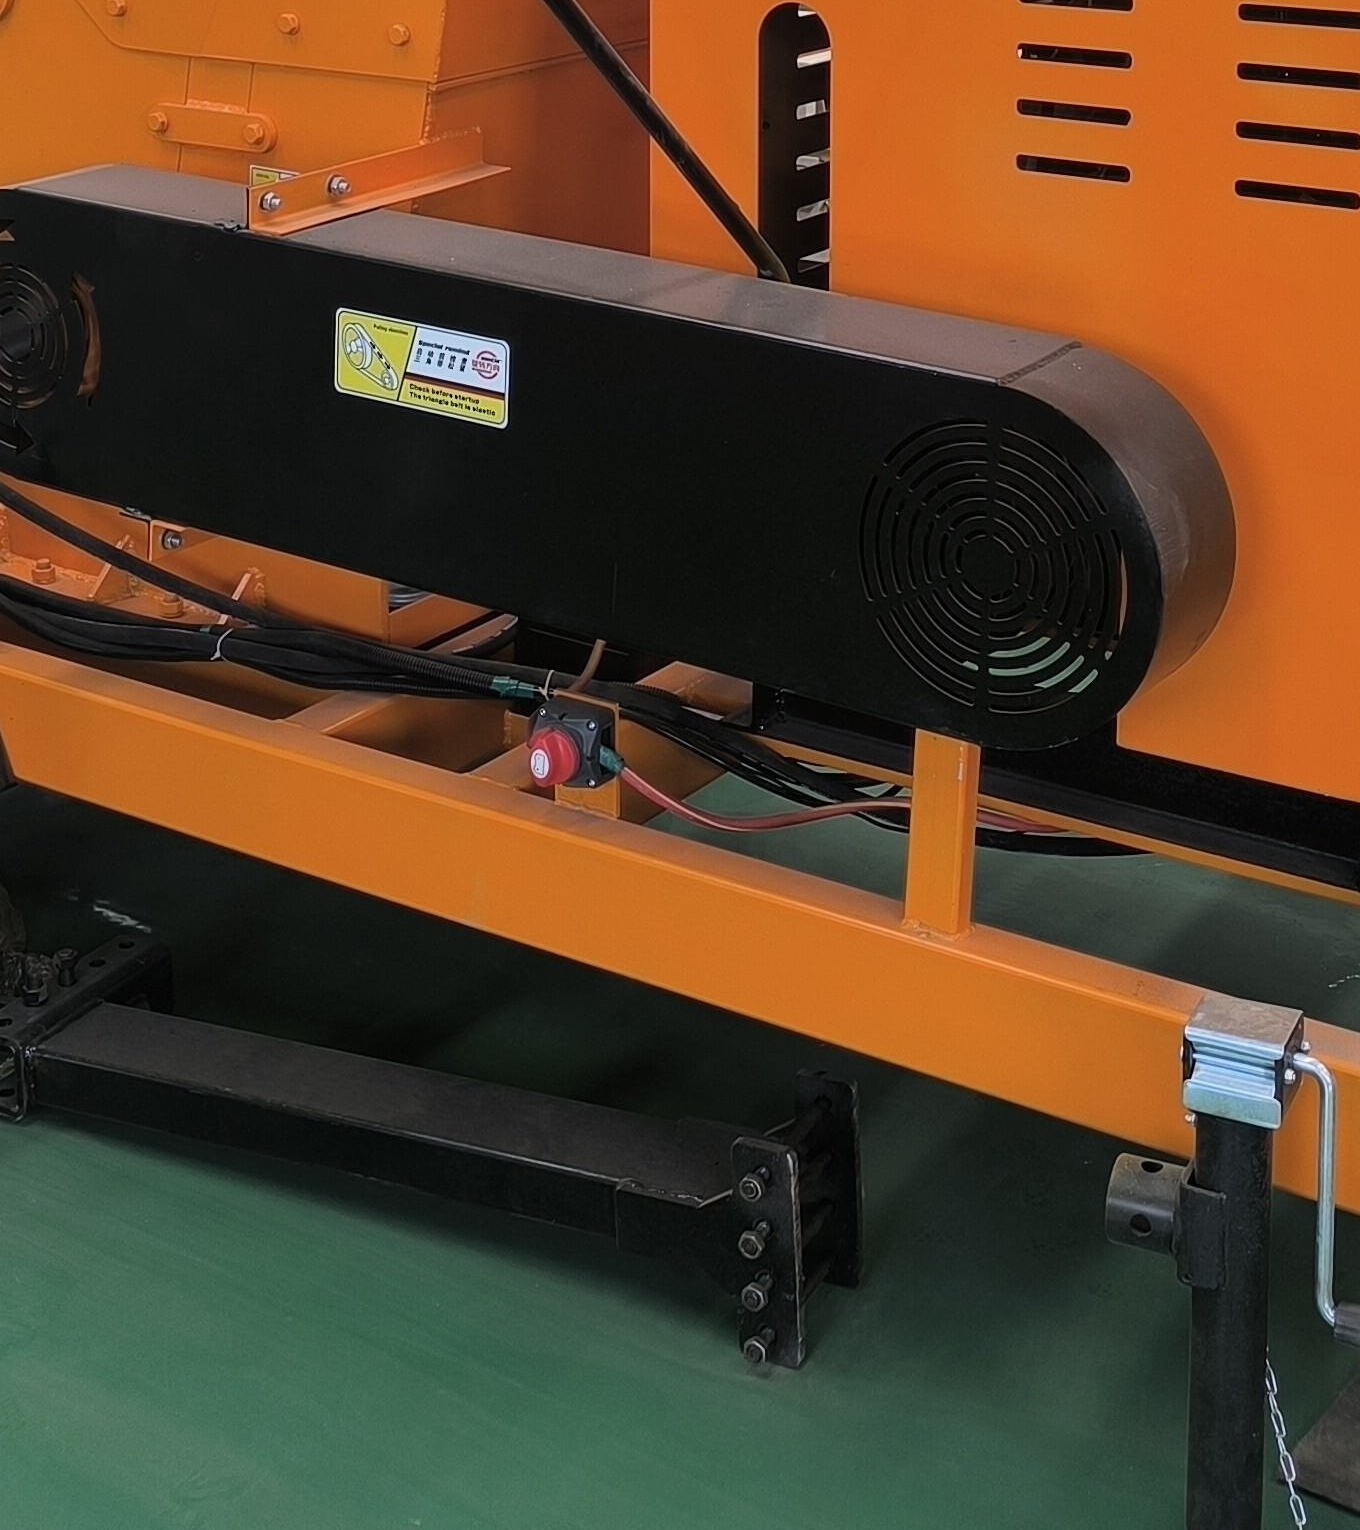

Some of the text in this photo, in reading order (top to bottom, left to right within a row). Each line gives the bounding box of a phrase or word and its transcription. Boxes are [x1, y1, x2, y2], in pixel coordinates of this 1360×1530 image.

[419, 340, 443, 349] Special
[409, 383, 480, 405] Check before startup
[409, 392, 422, 400] The
[423, 394, 449, 405] triangle
[450, 400, 464, 411] belt
